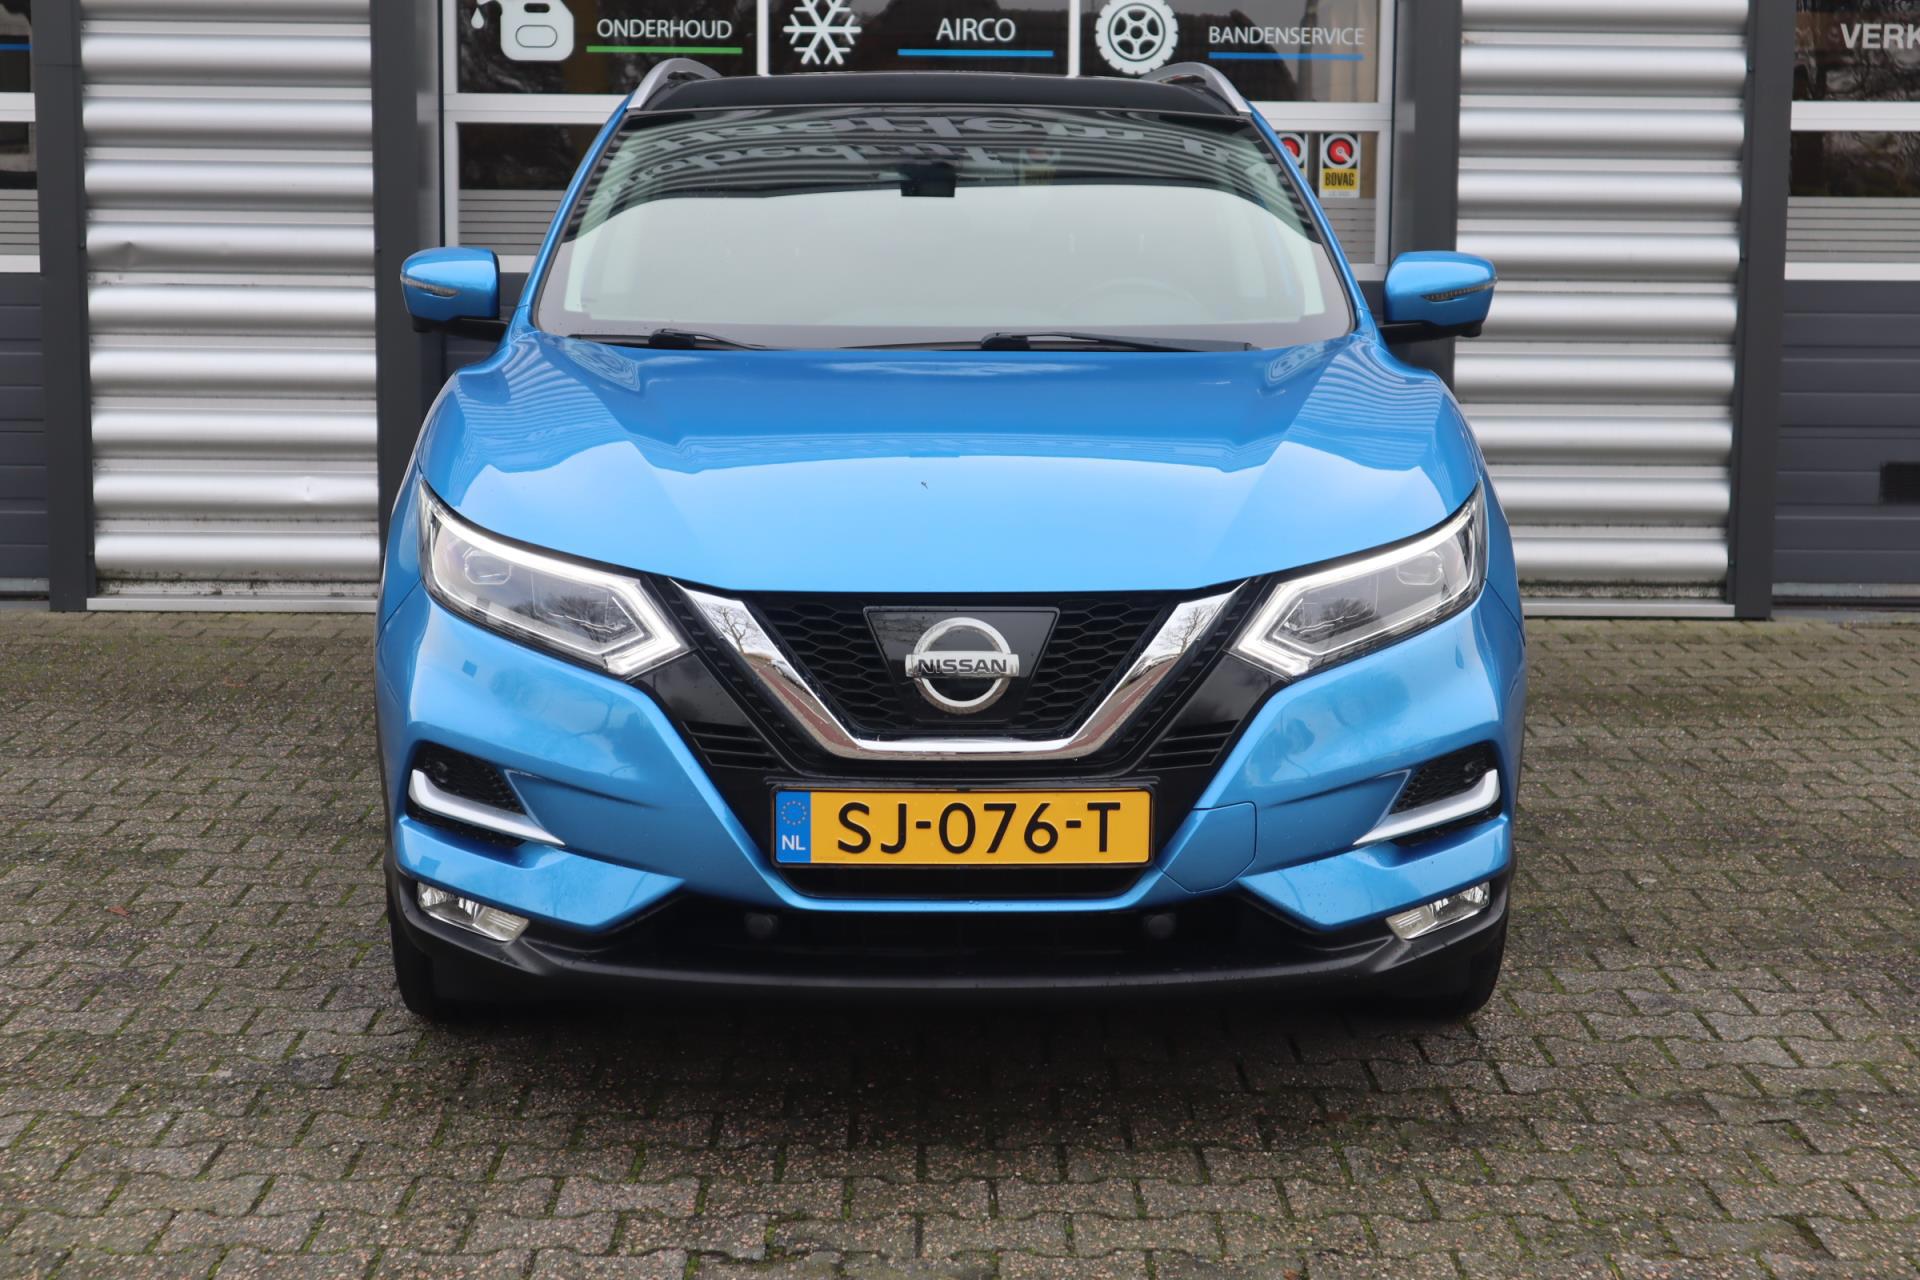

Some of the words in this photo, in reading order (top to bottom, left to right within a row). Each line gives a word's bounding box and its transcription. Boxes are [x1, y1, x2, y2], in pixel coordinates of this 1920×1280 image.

[596, 18, 733, 39] ONDERHOUD
[936, 18, 1016, 42] AIRCO
[1208, 26, 1365, 46] BANDENSERVICE
[1840, 23, 1920, 49] VERK
[1324, 172, 1354, 186] BOVAG
[917, 658, 1008, 674] NISSAN
[837, 802, 1121, 855] SJ-076-T
[781, 834, 806, 851] NL
